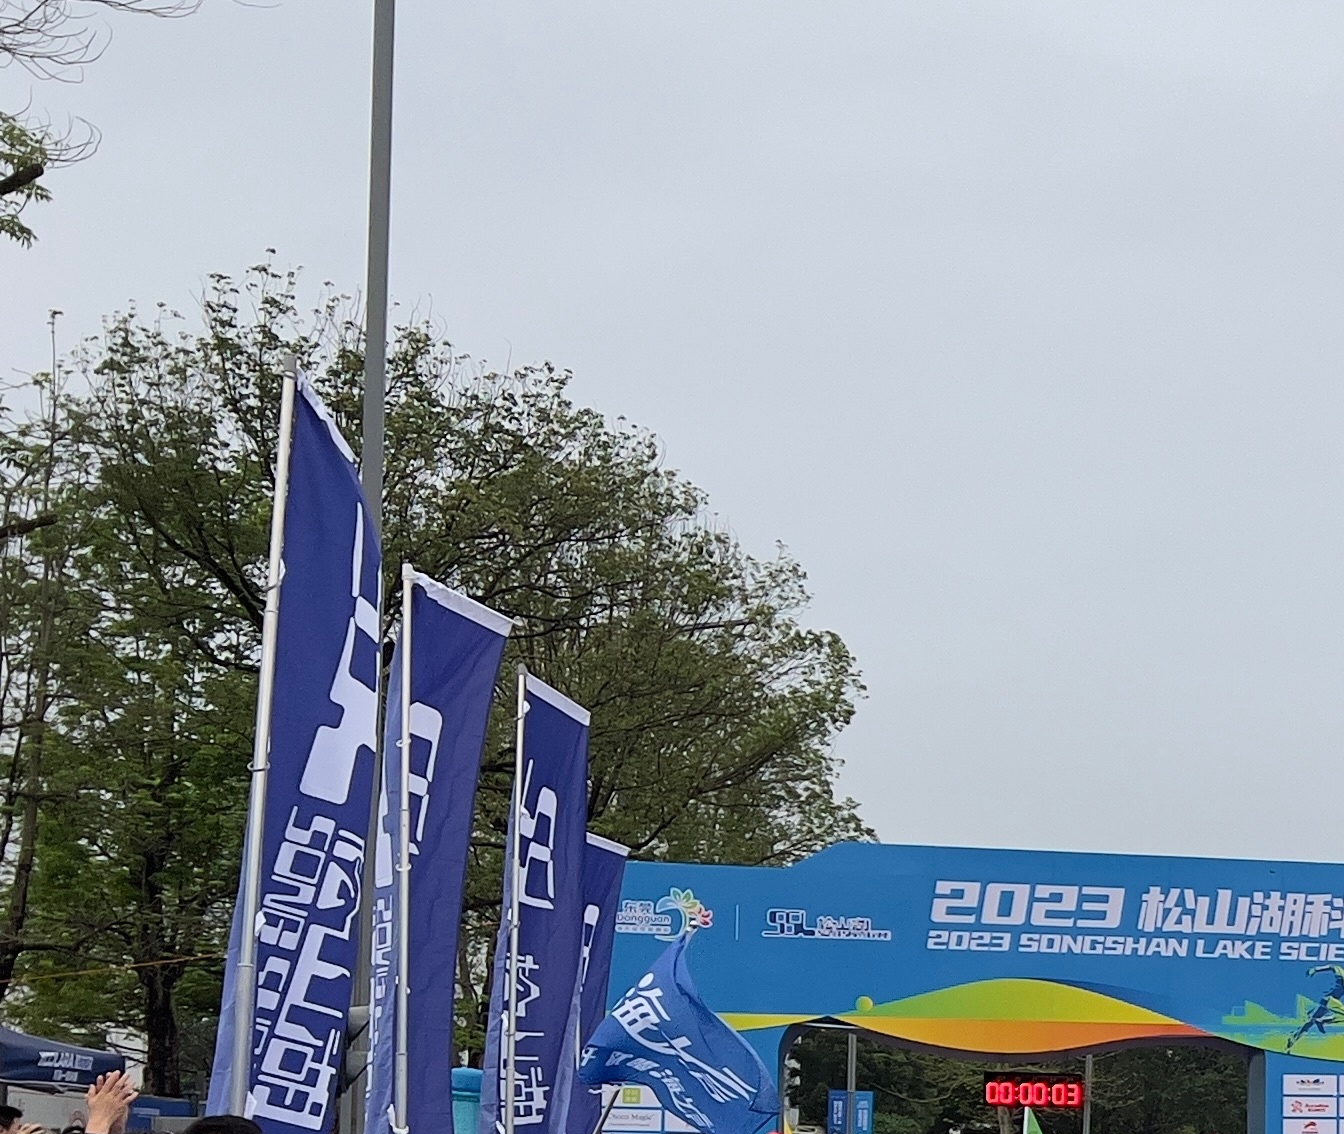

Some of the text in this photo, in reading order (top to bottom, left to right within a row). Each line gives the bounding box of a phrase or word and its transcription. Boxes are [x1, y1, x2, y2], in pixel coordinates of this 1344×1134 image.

[930, 880, 1125, 930] 2023
[927, 930, 1011, 952] 2023
[1018, 933, 1187, 958] SONGSHAN
[1194, 938, 1272, 961] LAKE
[986, 1082, 1080, 1105] 00:00:03
